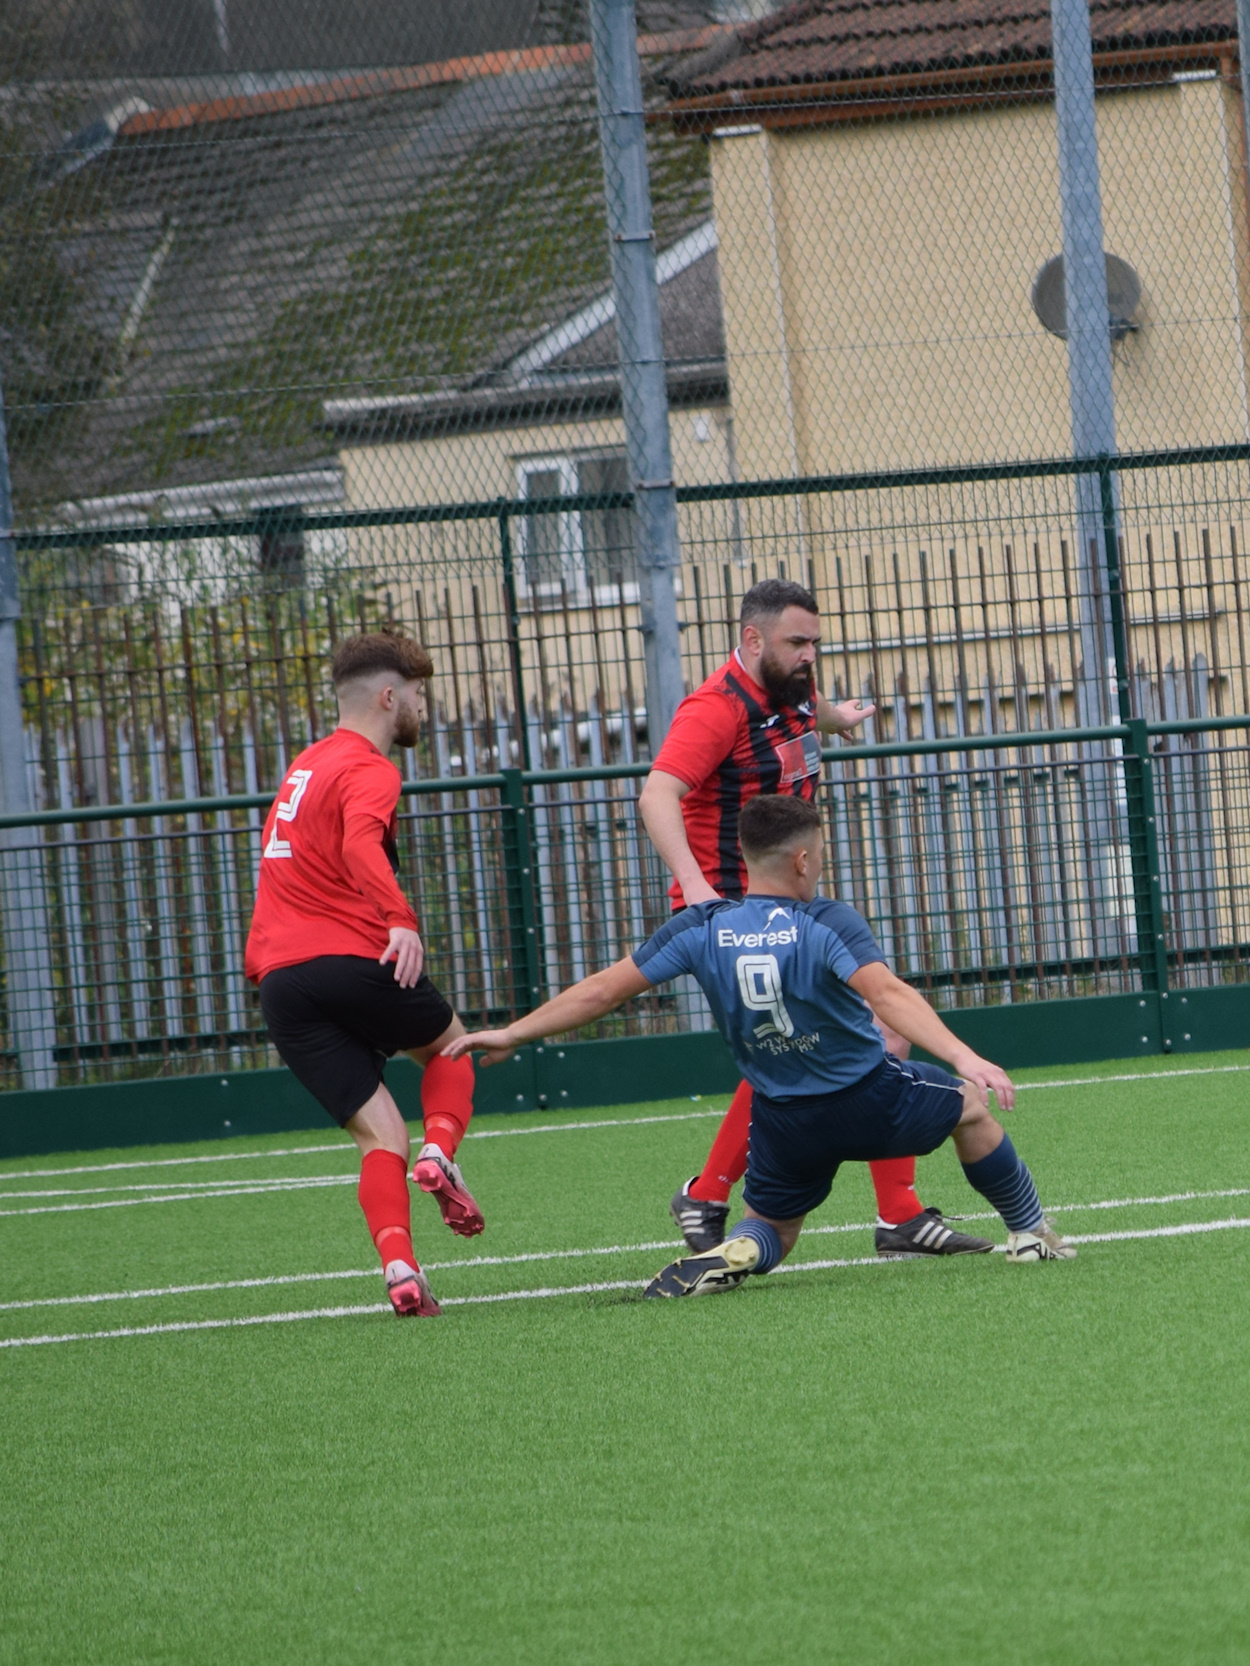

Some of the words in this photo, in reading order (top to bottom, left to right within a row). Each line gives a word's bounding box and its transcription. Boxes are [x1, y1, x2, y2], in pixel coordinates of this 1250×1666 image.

[264, 769, 313, 858] 2
[717, 925, 799, 947] Everest
[736, 954, 794, 1038] 9
[770, 1043, 814, 1056] SYSMS
[774, 1032, 820, 1049] WDOW
